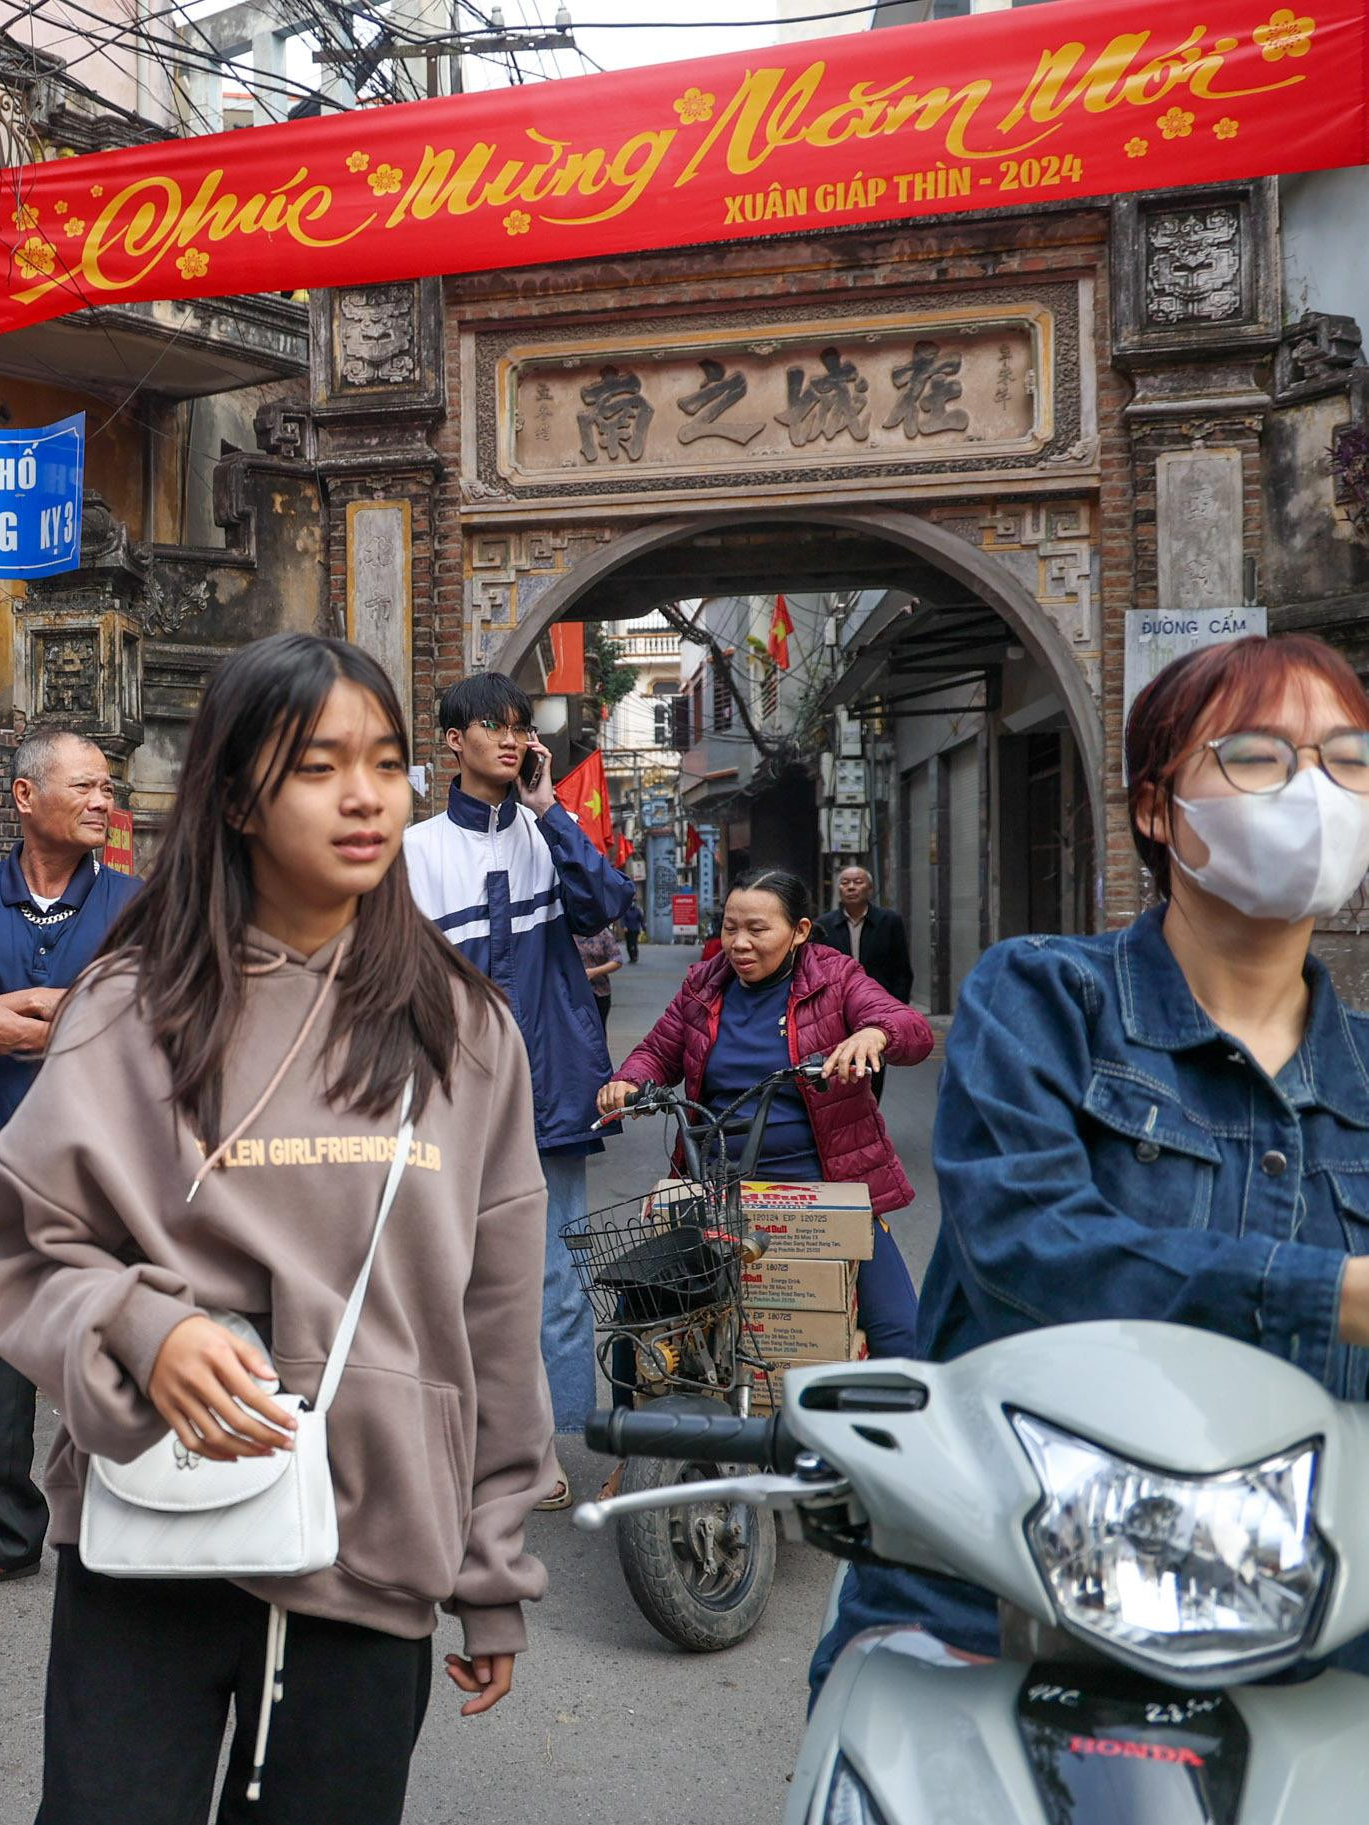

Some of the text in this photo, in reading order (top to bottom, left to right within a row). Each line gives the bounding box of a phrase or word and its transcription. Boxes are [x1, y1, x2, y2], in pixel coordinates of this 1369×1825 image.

[386, 127, 679, 228] Mừng
[674, 60, 1062, 187] Năm
[997, 25, 1306, 133] Mới
[723, 184, 808, 225] XUÂN
[815, 171, 888, 215] GIÁP
[893, 160, 971, 203] THÌN
[999, 154, 1084, 191] 2024
[61, 501, 74, 544] 3
[1141, 615, 1199, 635] ĐƯỜNG
[268, 1136, 400, 1167] GIRLFRIENDS
[771, 1224, 788, 1234] Bull
[1069, 1736, 1205, 1768] HONDA
